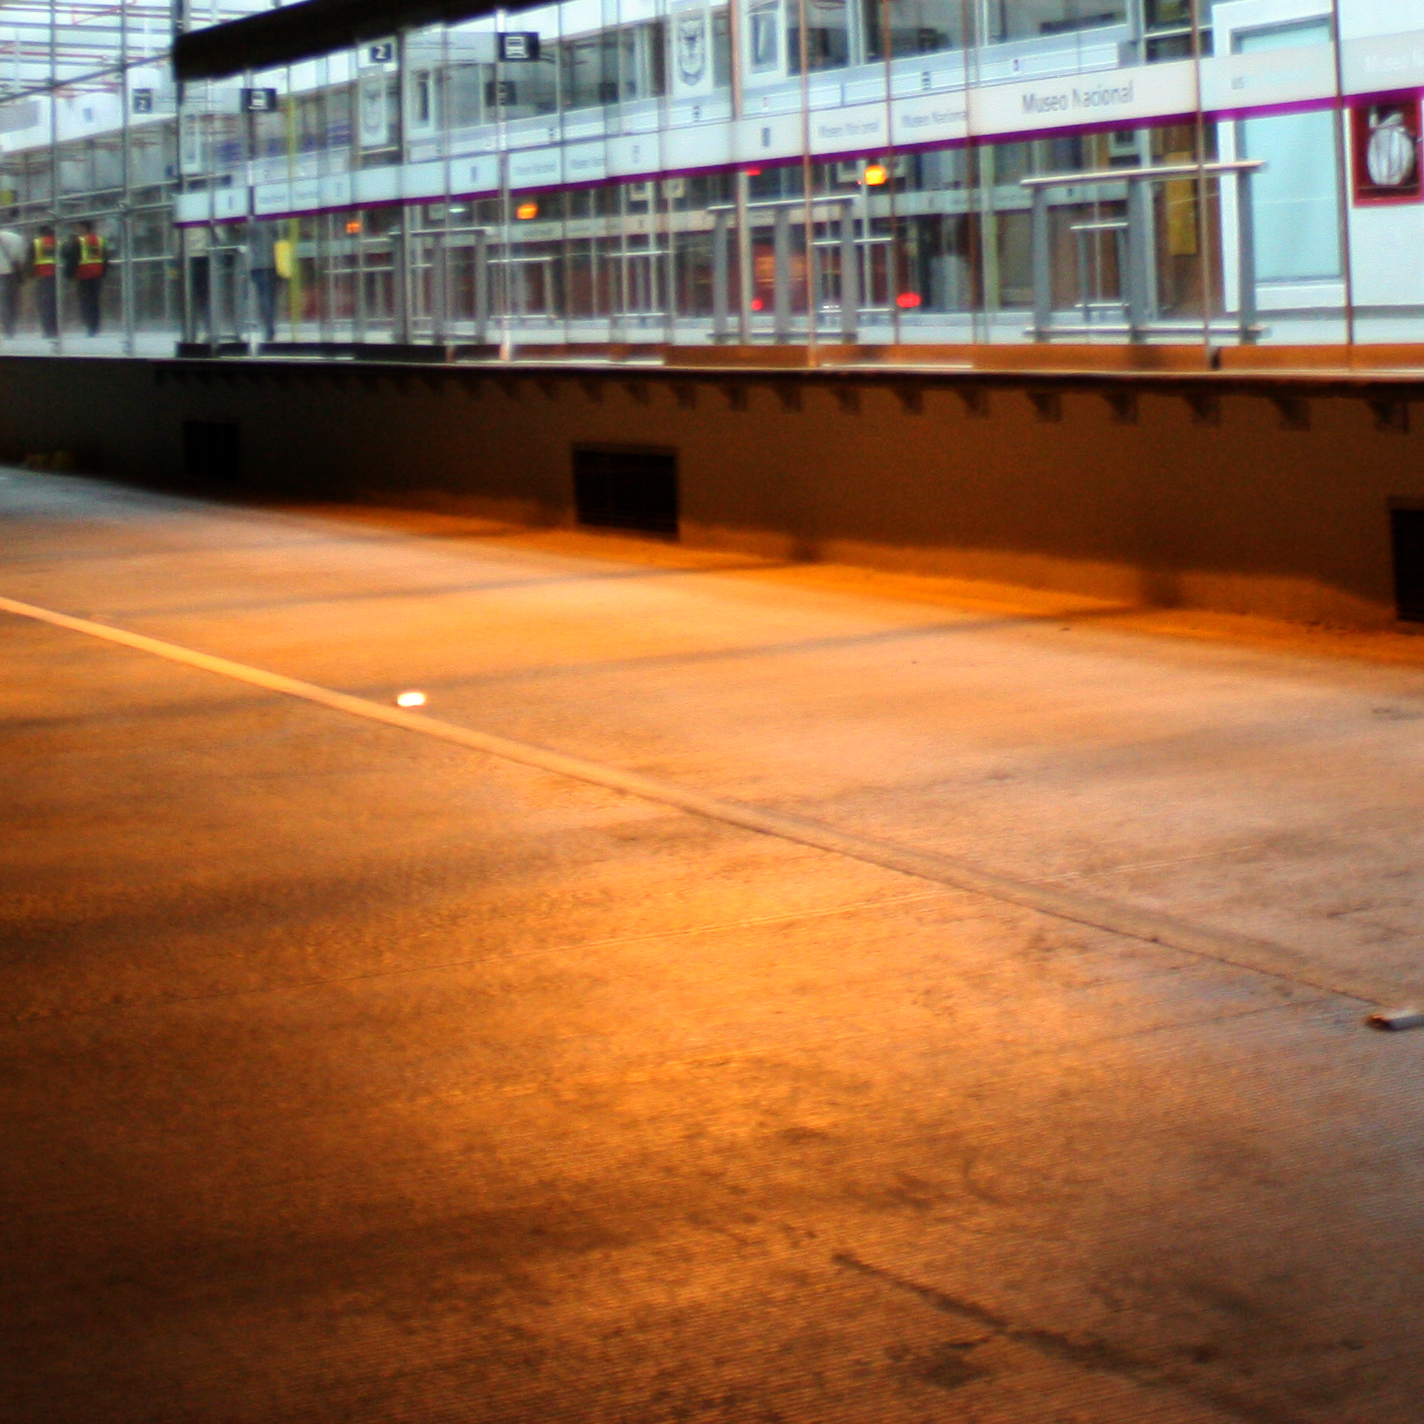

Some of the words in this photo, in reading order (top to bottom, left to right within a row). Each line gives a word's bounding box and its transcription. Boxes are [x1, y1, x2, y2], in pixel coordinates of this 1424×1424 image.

[376, 45, 387, 60] 2
[1022, 93, 1069, 114] Museo
[1072, 79, 1134, 110] Nacional
